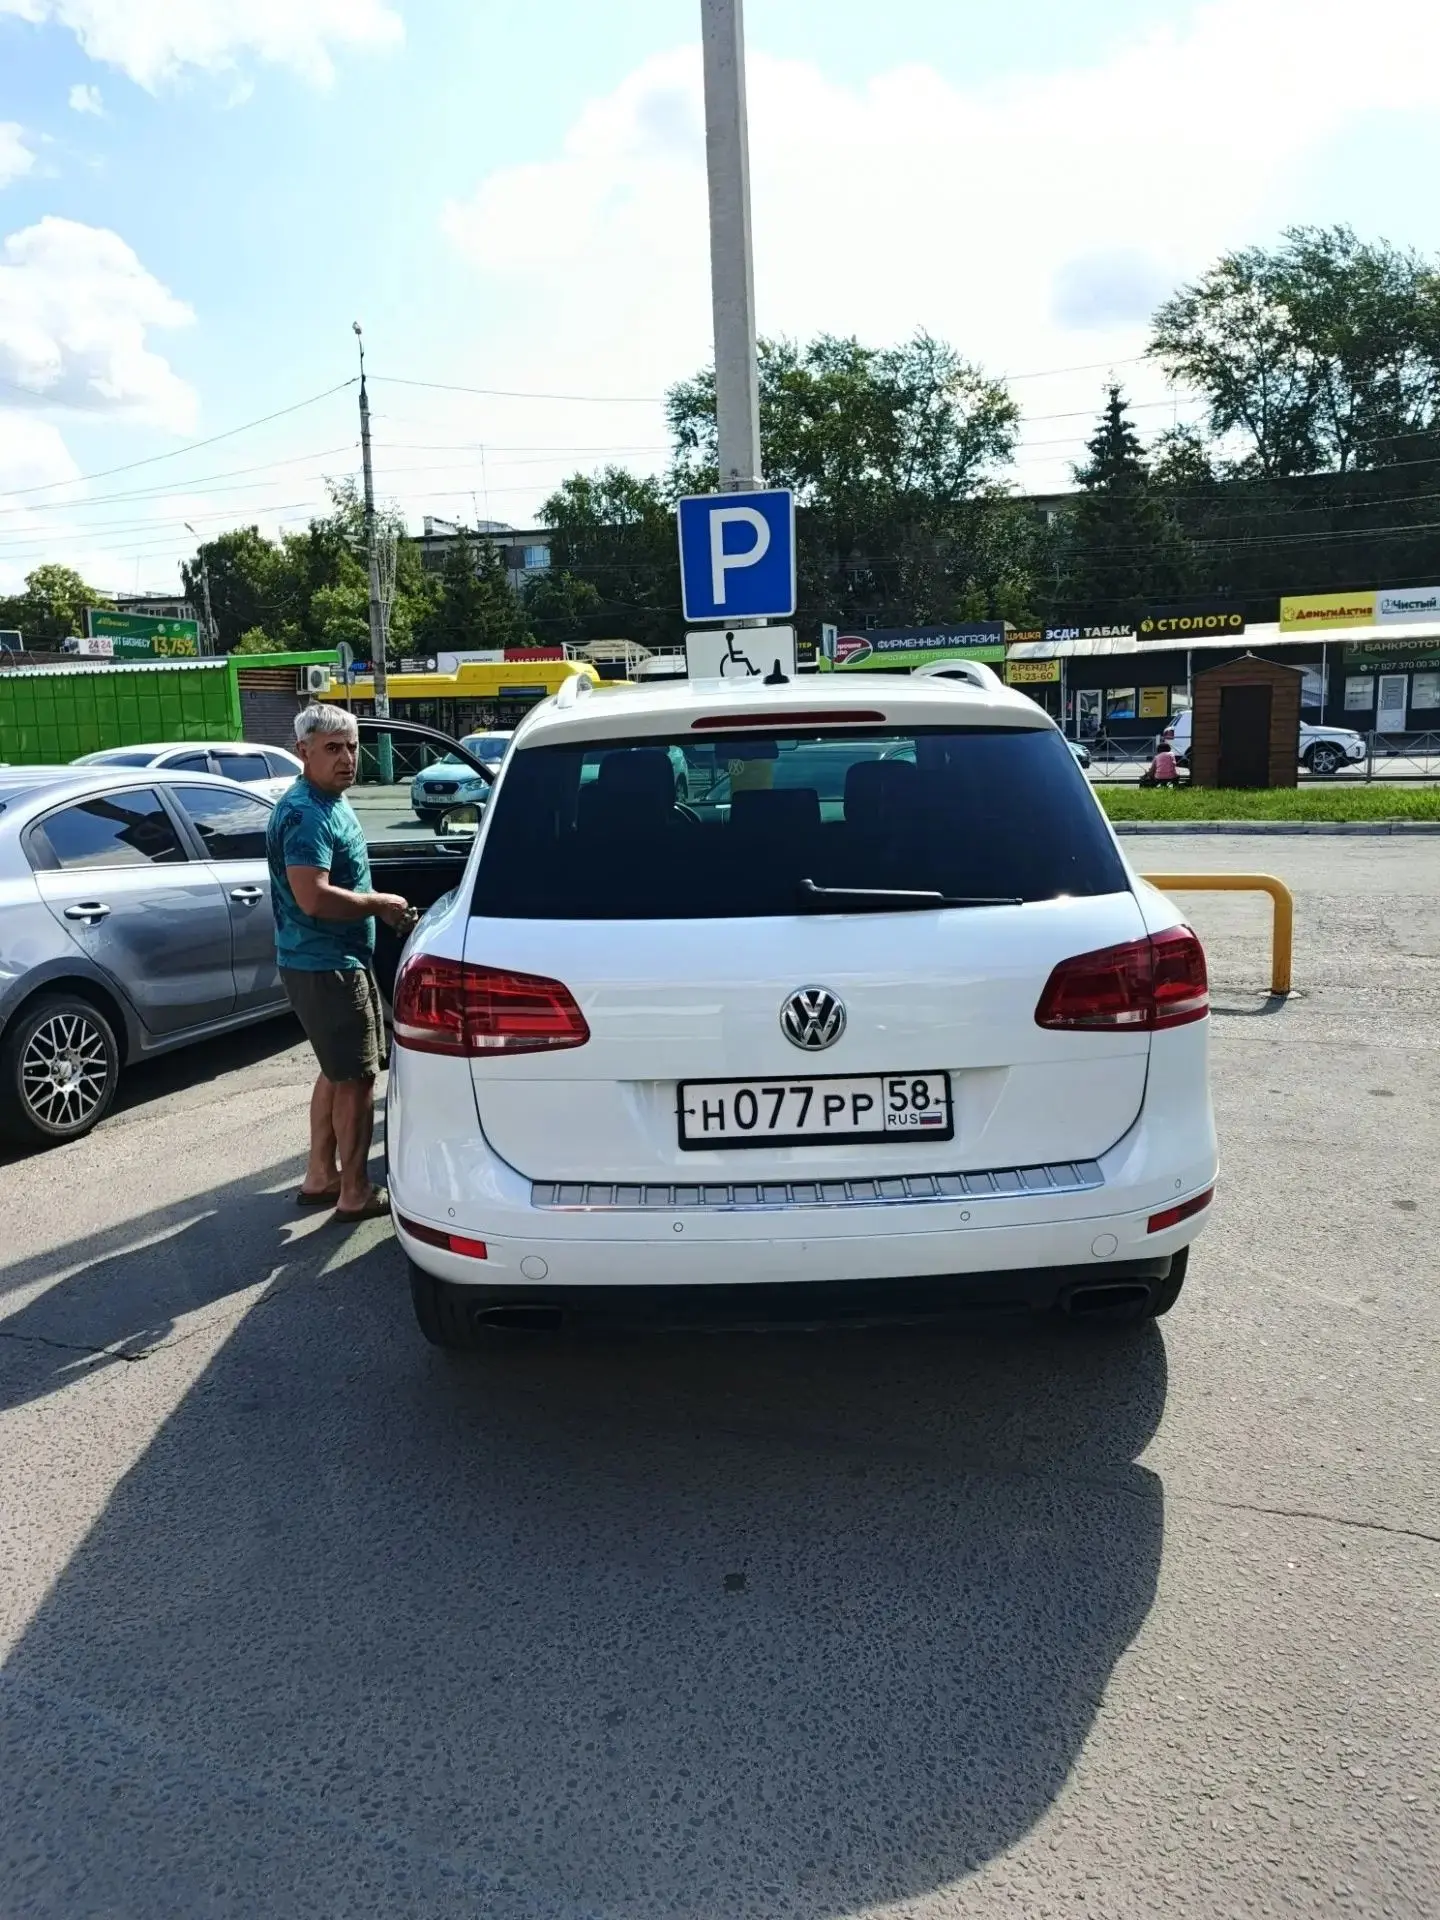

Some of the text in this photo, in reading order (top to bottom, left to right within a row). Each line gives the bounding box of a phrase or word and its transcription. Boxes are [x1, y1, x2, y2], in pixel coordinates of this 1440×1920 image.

[709, 506, 771, 605] P
[1393, 597, 1437, 610] Чистый
[1157, 614, 1243, 631] СТОЛОТО
[1084, 625, 1131, 637] ТАБАК
[151, 635, 198, 657] 13,75%
[877, 633, 1001, 649] ФИРМЕННЫЙ МАГАЗИН
[1010, 662, 1056, 672] АРЕНДА
[1012, 671, 1054, 681] 51-23-60
[888, 1079, 931, 1112] 58
[888, 1114, 918, 1126] RUS
